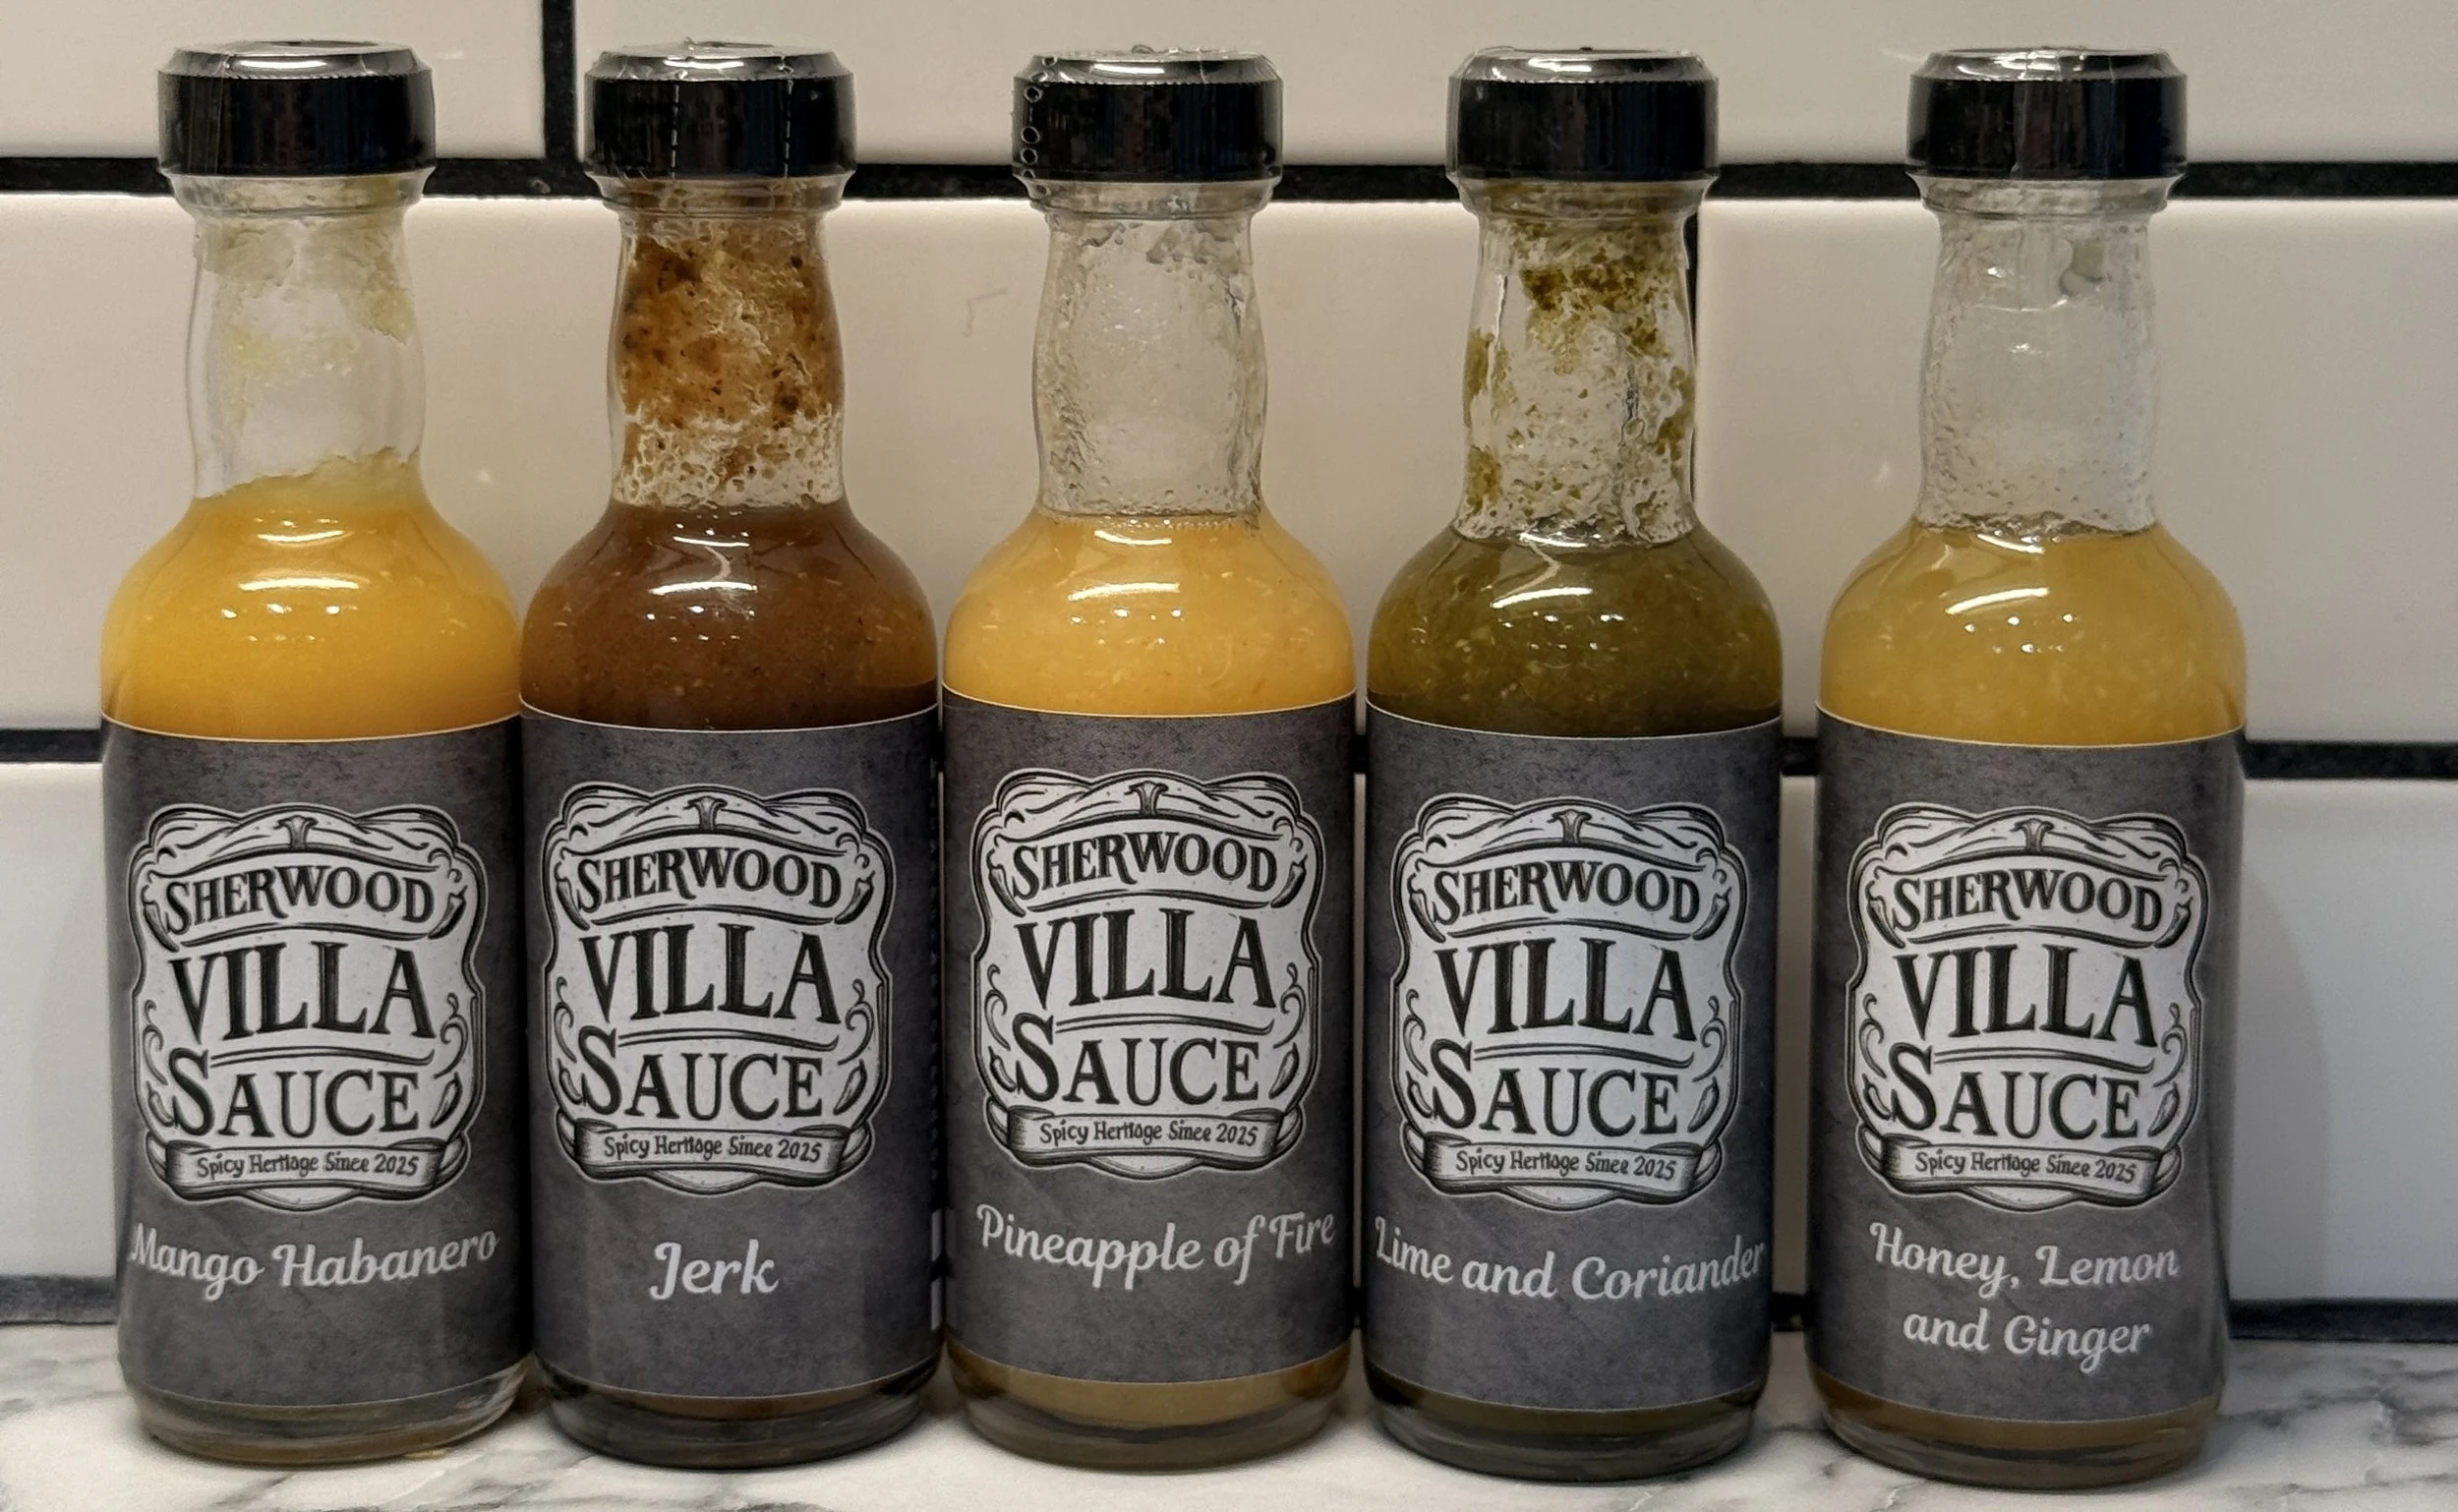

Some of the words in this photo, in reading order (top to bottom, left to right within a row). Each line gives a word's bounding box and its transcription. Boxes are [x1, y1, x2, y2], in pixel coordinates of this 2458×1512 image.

[165, 865, 436, 935] SHERWOOD
[576, 846, 842, 912] SHERWOOD
[1012, 832, 1279, 901] SHERWOOD
[1433, 860, 1701, 926] SHERWOOD
[1893, 868, 2163, 933] SHERWOOD
[168, 941, 436, 1045] VILLA
[578, 922, 842, 1025] VILLA
[1014, 907, 1277, 1010] VILLA
[1433, 936, 1698, 1042] VILLA
[1893, 943, 2159, 1049] VILLA
[168, 1048, 421, 1138] SAUCE
[576, 1025, 824, 1121] SAUCE
[1012, 1012, 1259, 1106] SAUCE
[1431, 1037, 1679, 1137] SAUCE
[1889, 1042, 2140, 1139] SAUCE
[197, 1152, 244, 1180] Spicy
[374, 1152, 419, 1177] 2025
[604, 1133, 650, 1160] Spicy
[778, 1138, 823, 1163] 2025
[1039, 1119, 1088, 1147] Spicy
[1215, 1123, 1258, 1147] 2025
[1455, 1147, 1505, 1175] Spicy
[1633, 1155, 1677, 1181] 2025
[1914, 1148, 1966, 1176] Spicy
[2094, 1158, 2136, 1184] 2025
[129, 1223, 264, 1302] Mango
[271, 1229, 499, 1288] Habanero
[648, 1239, 780, 1302] Jerk
[975, 1202, 1204, 1291] Pineapple
[1214, 1214, 1267, 1286] of
[1270, 1211, 1337, 1260] Fire
[1375, 1216, 1455, 1284] Lime
[1461, 1250, 1558, 1300] and
[1571, 1233, 1766, 1302] Coriander
[1869, 1221, 2020, 1300] Honey,
[2034, 1245, 2179, 1288] Lemon
[1902, 1308, 1991, 1353] and
[2003, 1313, 2153, 1374] Ginger
